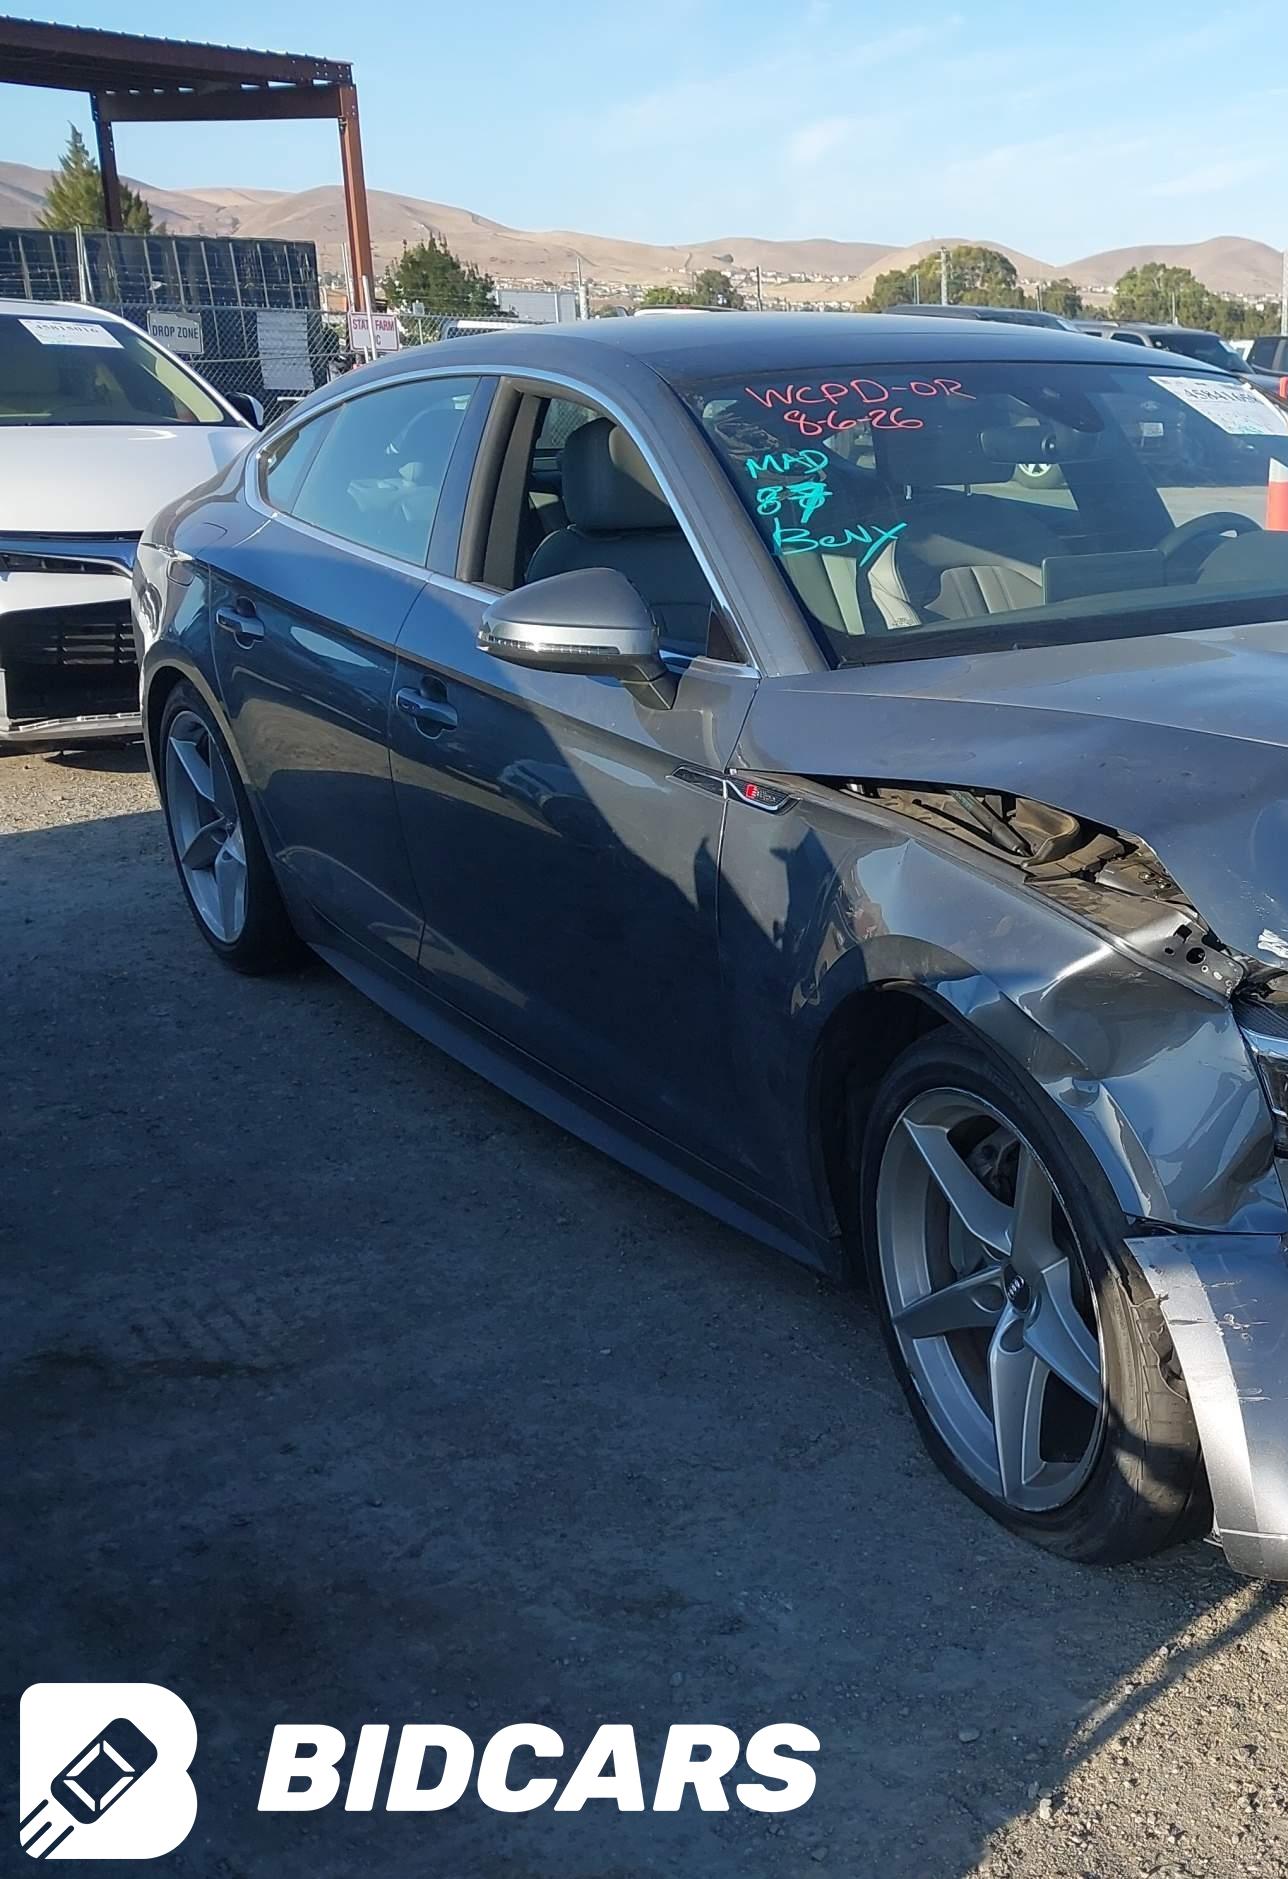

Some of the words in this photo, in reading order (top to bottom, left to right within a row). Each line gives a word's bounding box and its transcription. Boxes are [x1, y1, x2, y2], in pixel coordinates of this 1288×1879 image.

[152, 325, 175, 337] DROP
[177, 326, 199, 339] ZONE
[353, 319, 369, 330] STAT
[375, 320, 394, 331] FARM
[783, 407, 924, 436] 8-6-26
[745, 449, 829, 479] MAD
